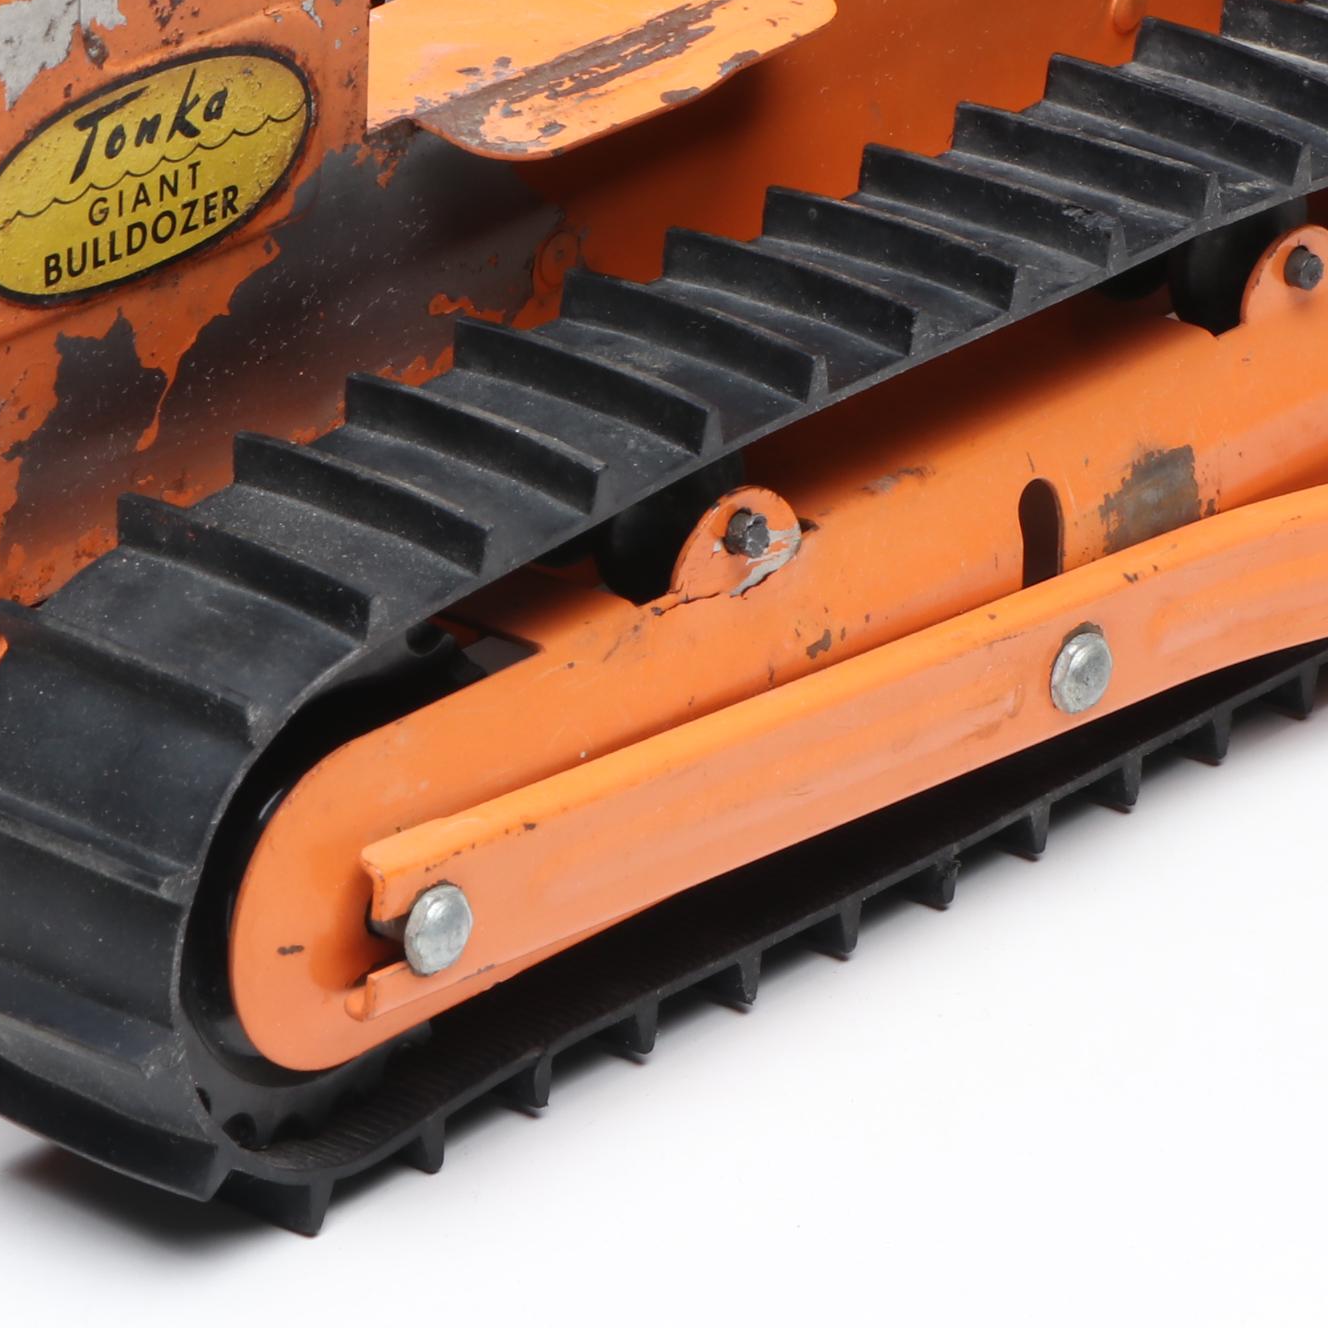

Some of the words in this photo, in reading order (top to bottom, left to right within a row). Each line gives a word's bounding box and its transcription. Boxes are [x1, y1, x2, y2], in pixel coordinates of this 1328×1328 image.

[69, 68, 228, 185] Tonka
[43, 184, 239, 288] BULLDOZER
[88, 161, 202, 226] GIANT
